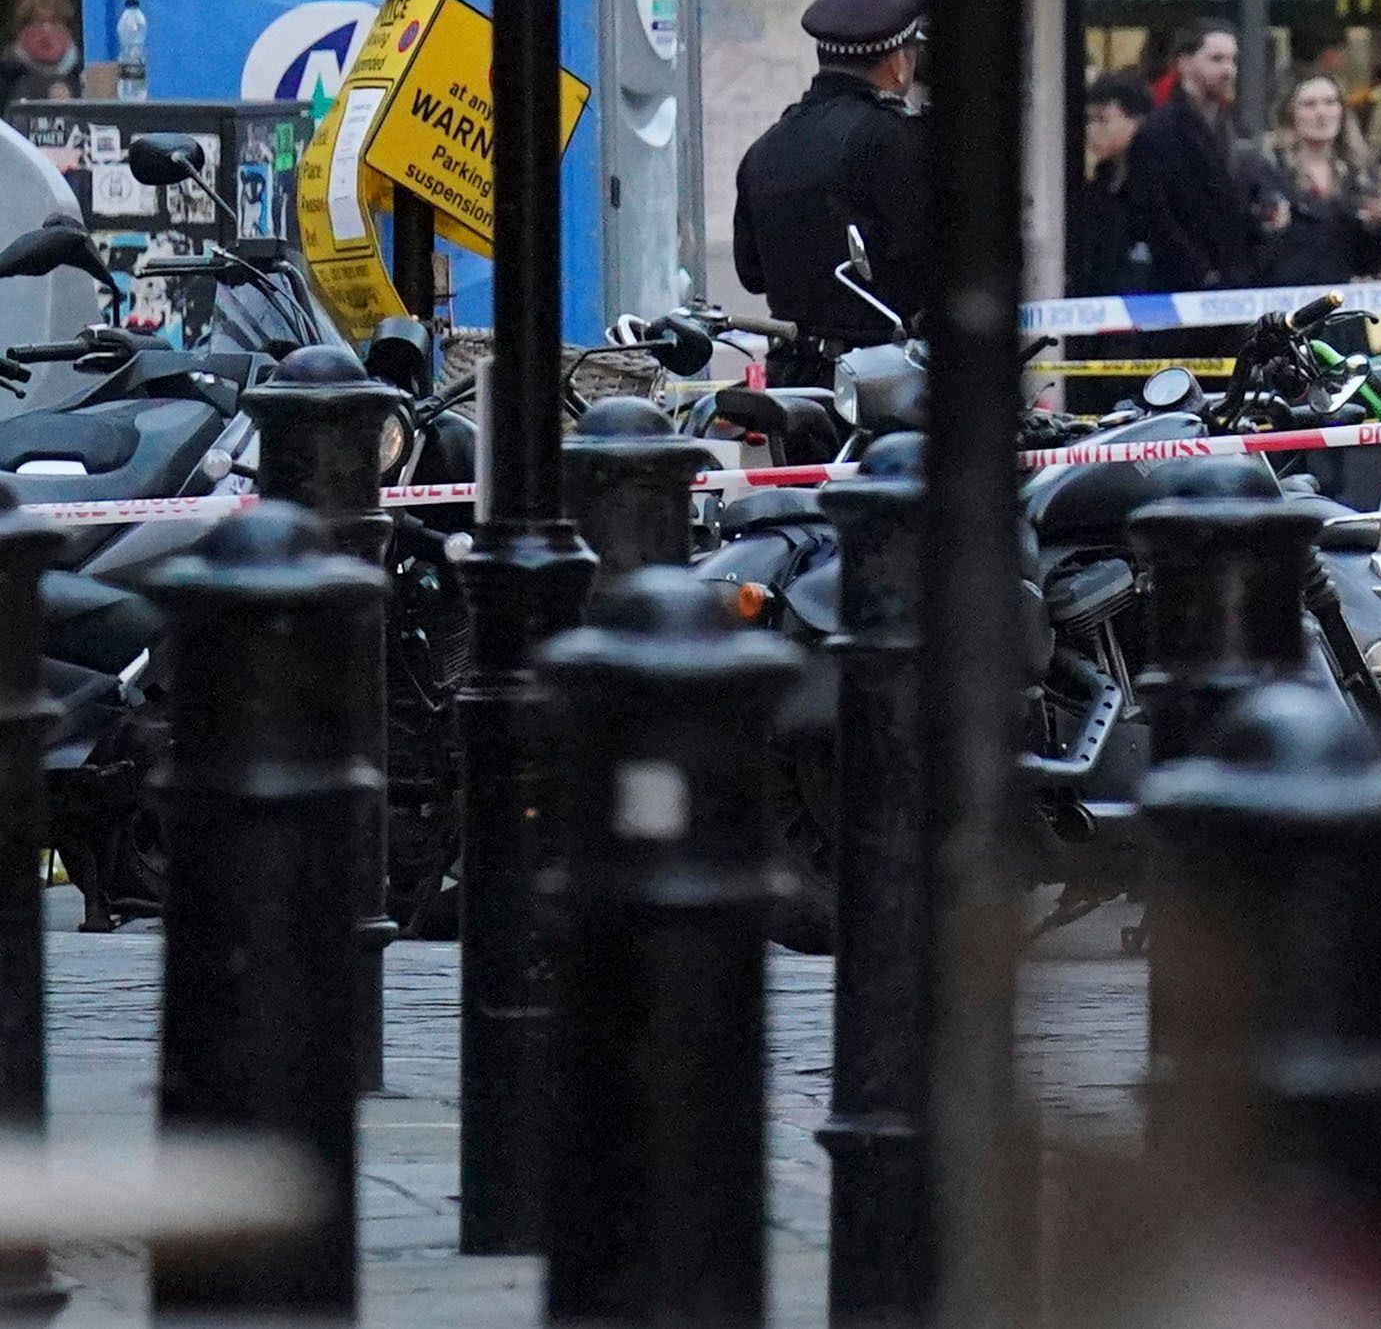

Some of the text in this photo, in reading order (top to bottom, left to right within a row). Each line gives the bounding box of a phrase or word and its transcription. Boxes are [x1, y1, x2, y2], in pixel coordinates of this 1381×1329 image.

[449, 81, 468, 104] at
[410, 86, 495, 163] WARN
[431, 144, 494, 199] Parking
